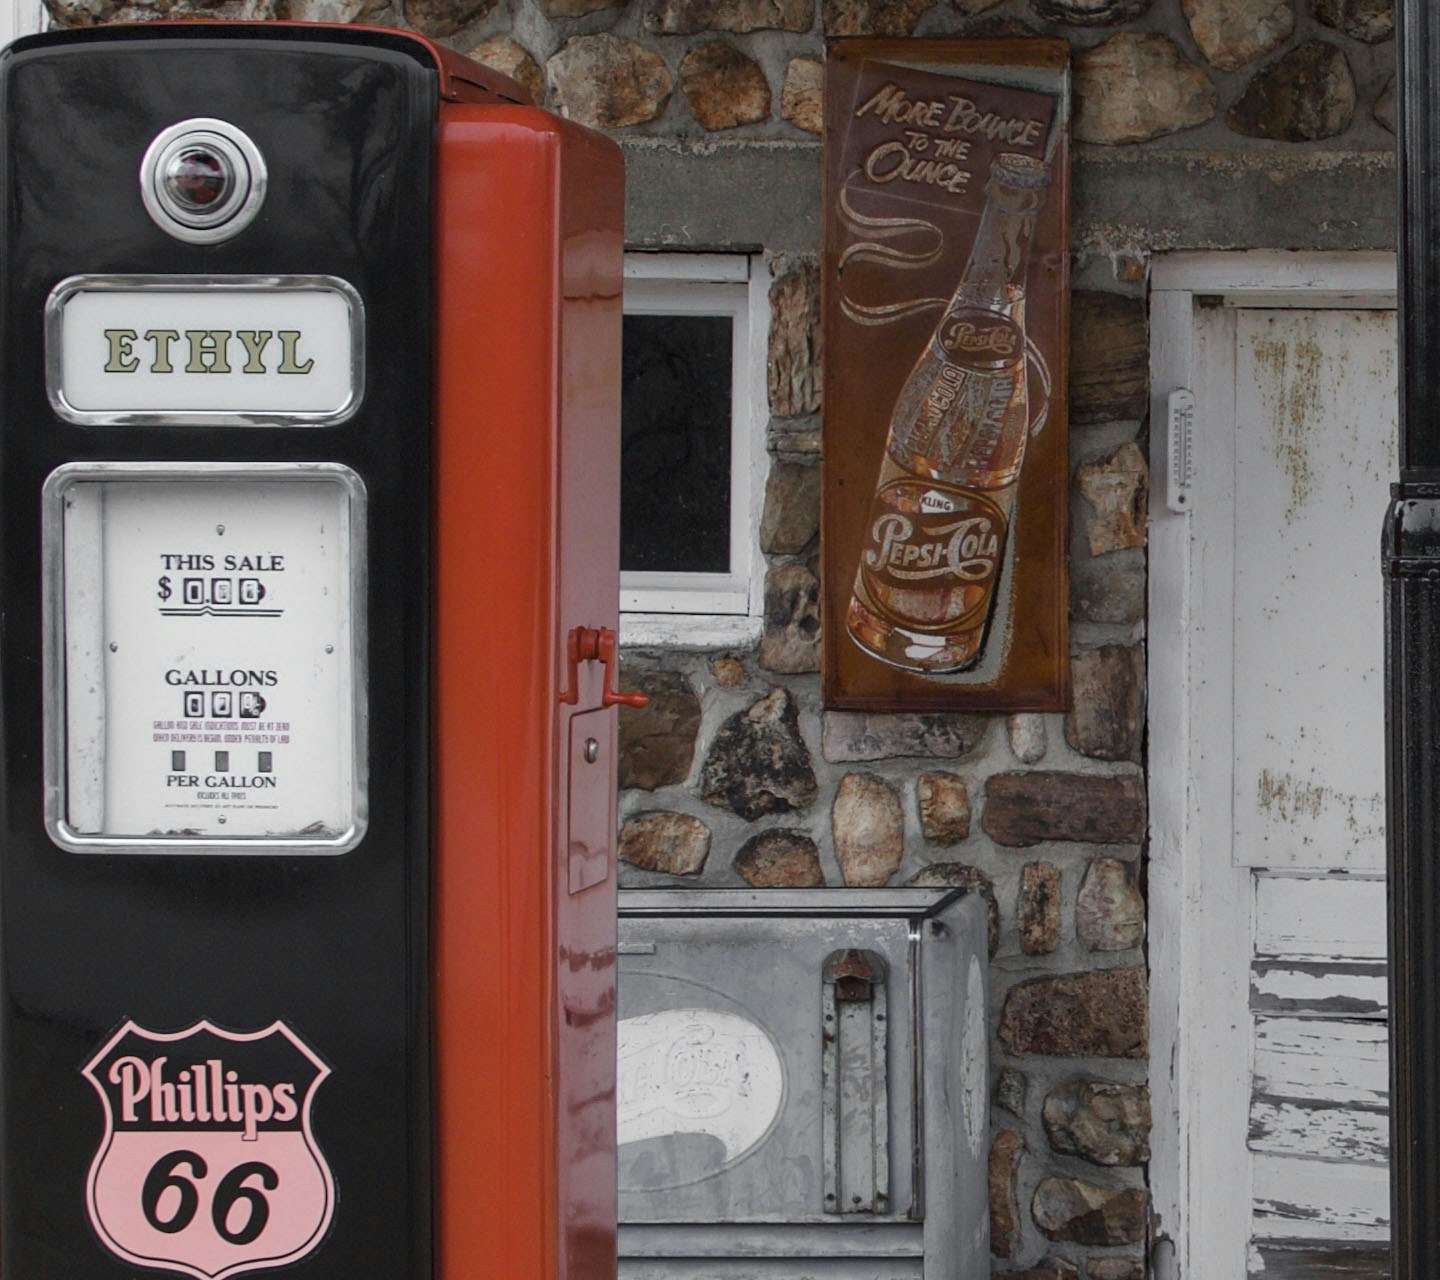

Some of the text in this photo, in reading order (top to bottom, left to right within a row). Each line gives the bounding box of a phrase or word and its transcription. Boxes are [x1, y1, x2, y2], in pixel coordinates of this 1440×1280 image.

[855, 82, 1045, 146] MORE BOUNCE
[867, 141, 972, 194] OUNCE
[905, 130, 972, 160] TO THE
[104, 329, 314, 374] ETHYL
[160, 554, 285, 571] THIS SALE
[862, 513, 998, 581] PEPSI-COLA
[157, 575, 172, 602] $
[165, 669, 278, 687] GALLONS
[167, 775, 277, 788] PER GALLON
[108, 1056, 298, 1141] Phillips
[141, 1149, 279, 1245] 66
